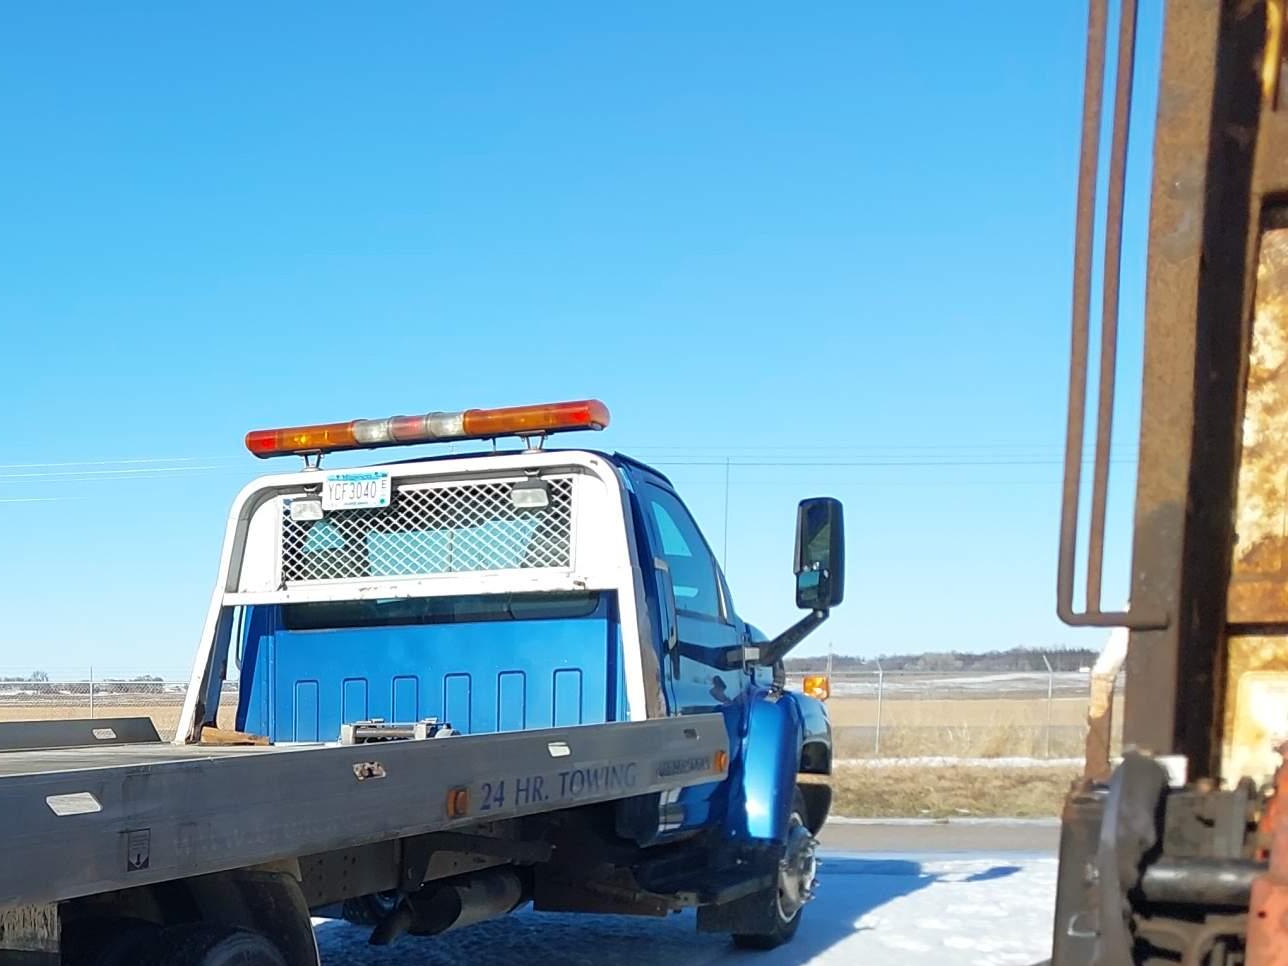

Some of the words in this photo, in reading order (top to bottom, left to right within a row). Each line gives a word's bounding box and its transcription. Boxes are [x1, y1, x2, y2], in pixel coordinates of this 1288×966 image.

[328, 481, 378, 502] YCF3040
[479, 782, 505, 811] 24
[514, 775, 550, 804] HR.
[558, 761, 638, 798] TOWING
